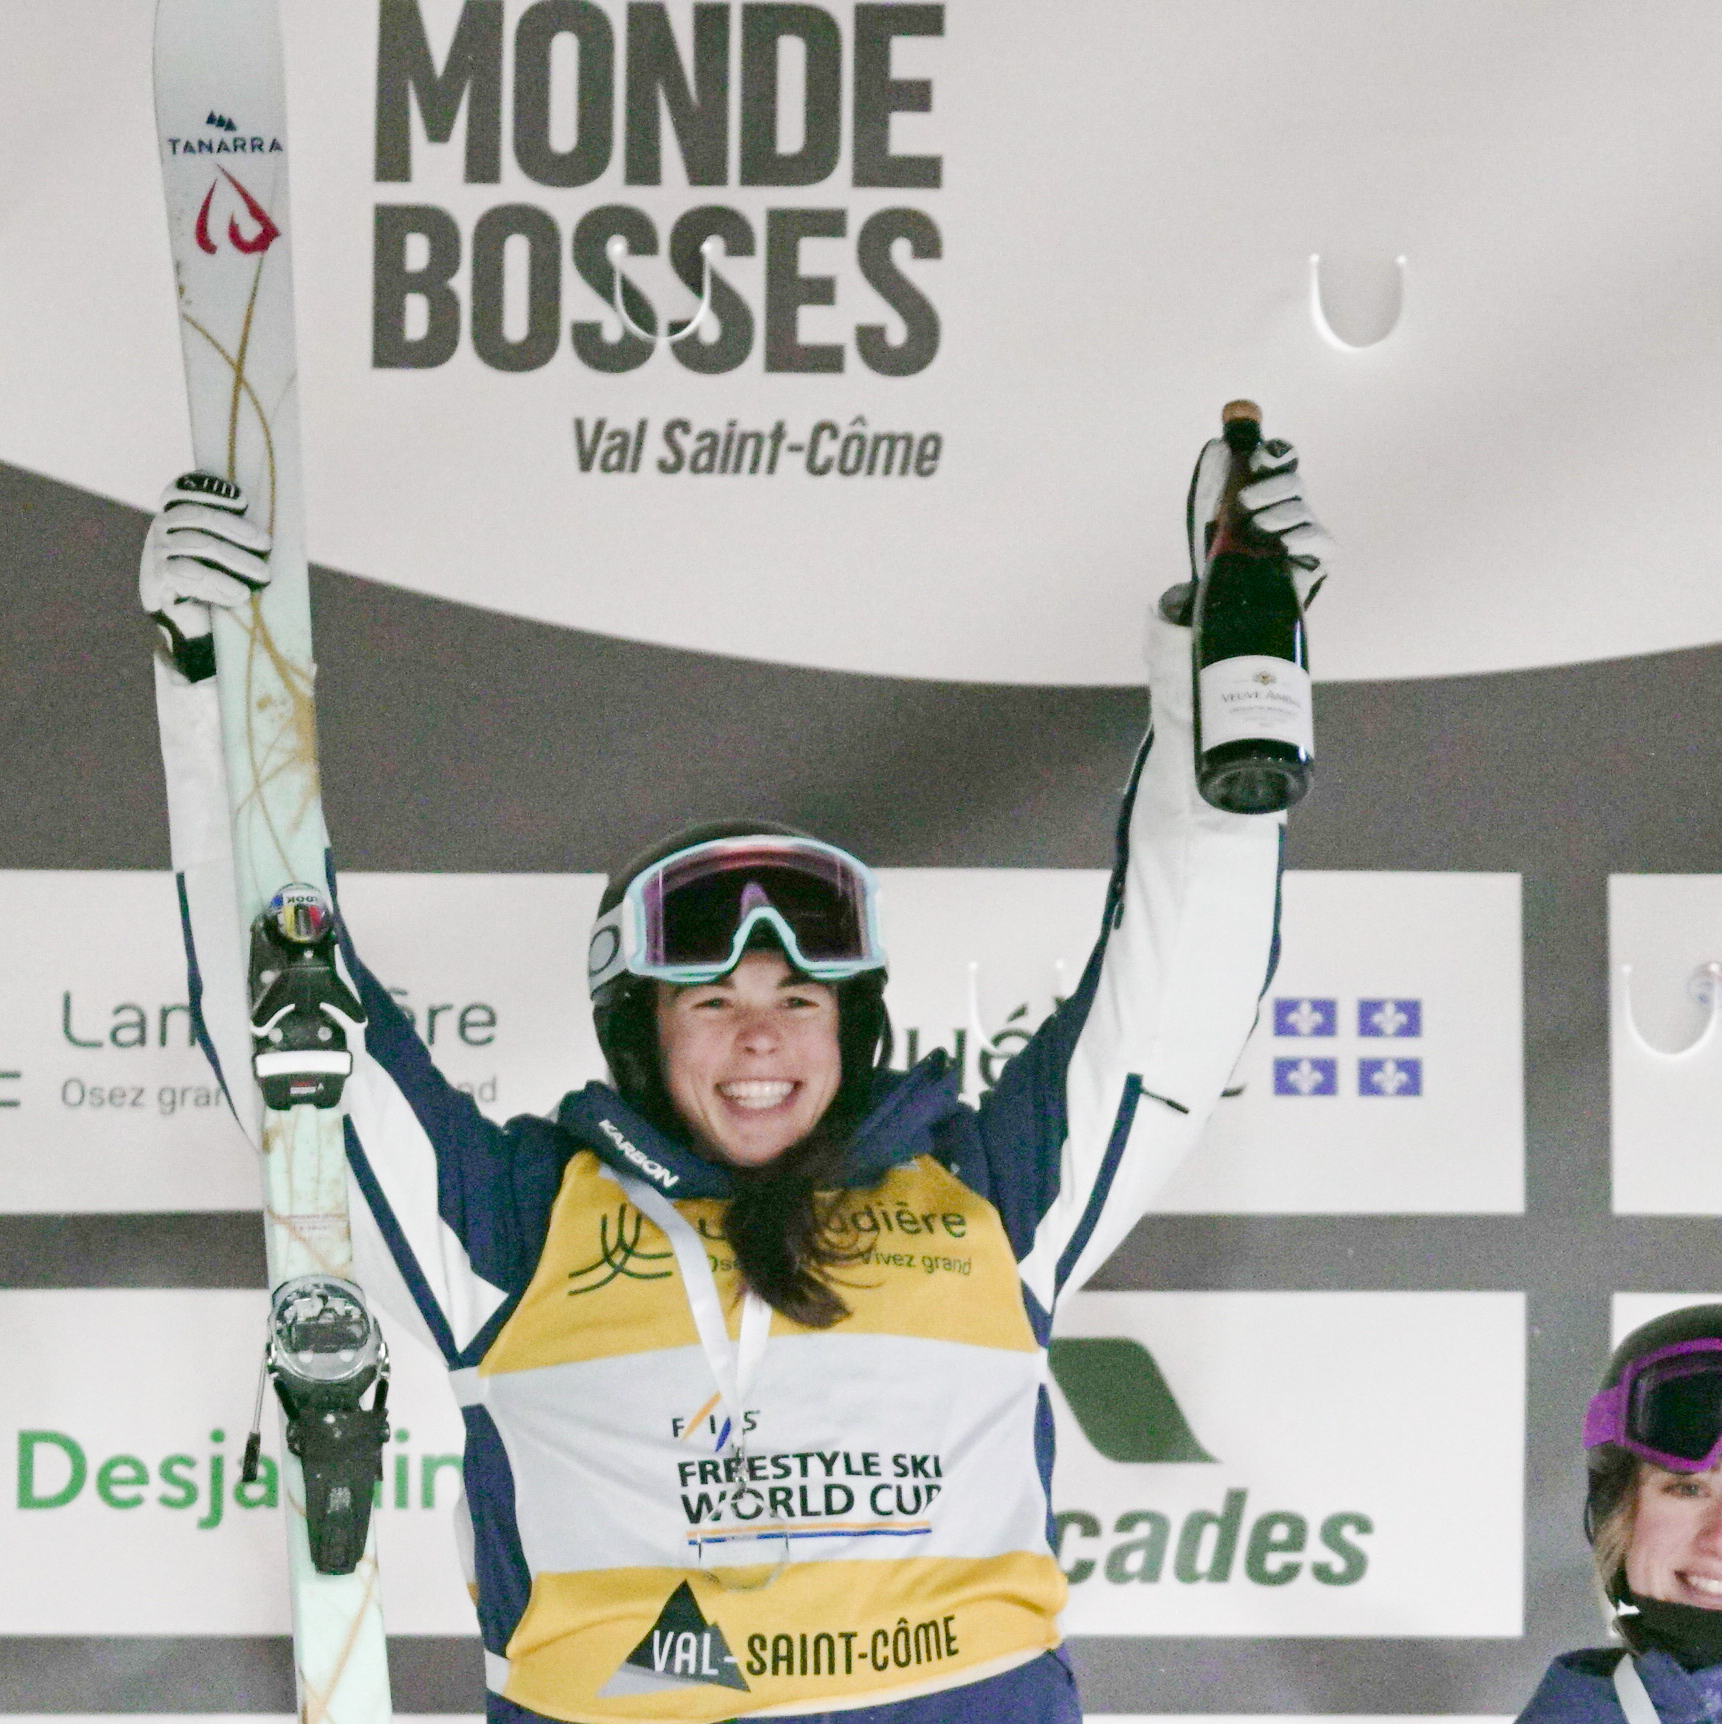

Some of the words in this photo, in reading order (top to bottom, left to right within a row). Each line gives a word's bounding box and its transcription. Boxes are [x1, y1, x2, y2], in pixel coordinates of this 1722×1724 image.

[374, 0, 946, 189] MONDE
[168, 137, 284, 155] TANARRA
[371, 203, 944, 378] BOSSES
[575, 417, 641, 475] Val
[656, 414, 942, 478] Saint-Côme
[62, 1077, 145, 1107] Osez
[598, 1118, 679, 1188] KARBON
[922, 1255, 973, 1277] grand
[678, 1451, 882, 1487] FREESTYLE
[892, 1453, 943, 1478] SKI
[681, 1483, 855, 1525] WORLD
[869, 1483, 942, 1517] CUP
